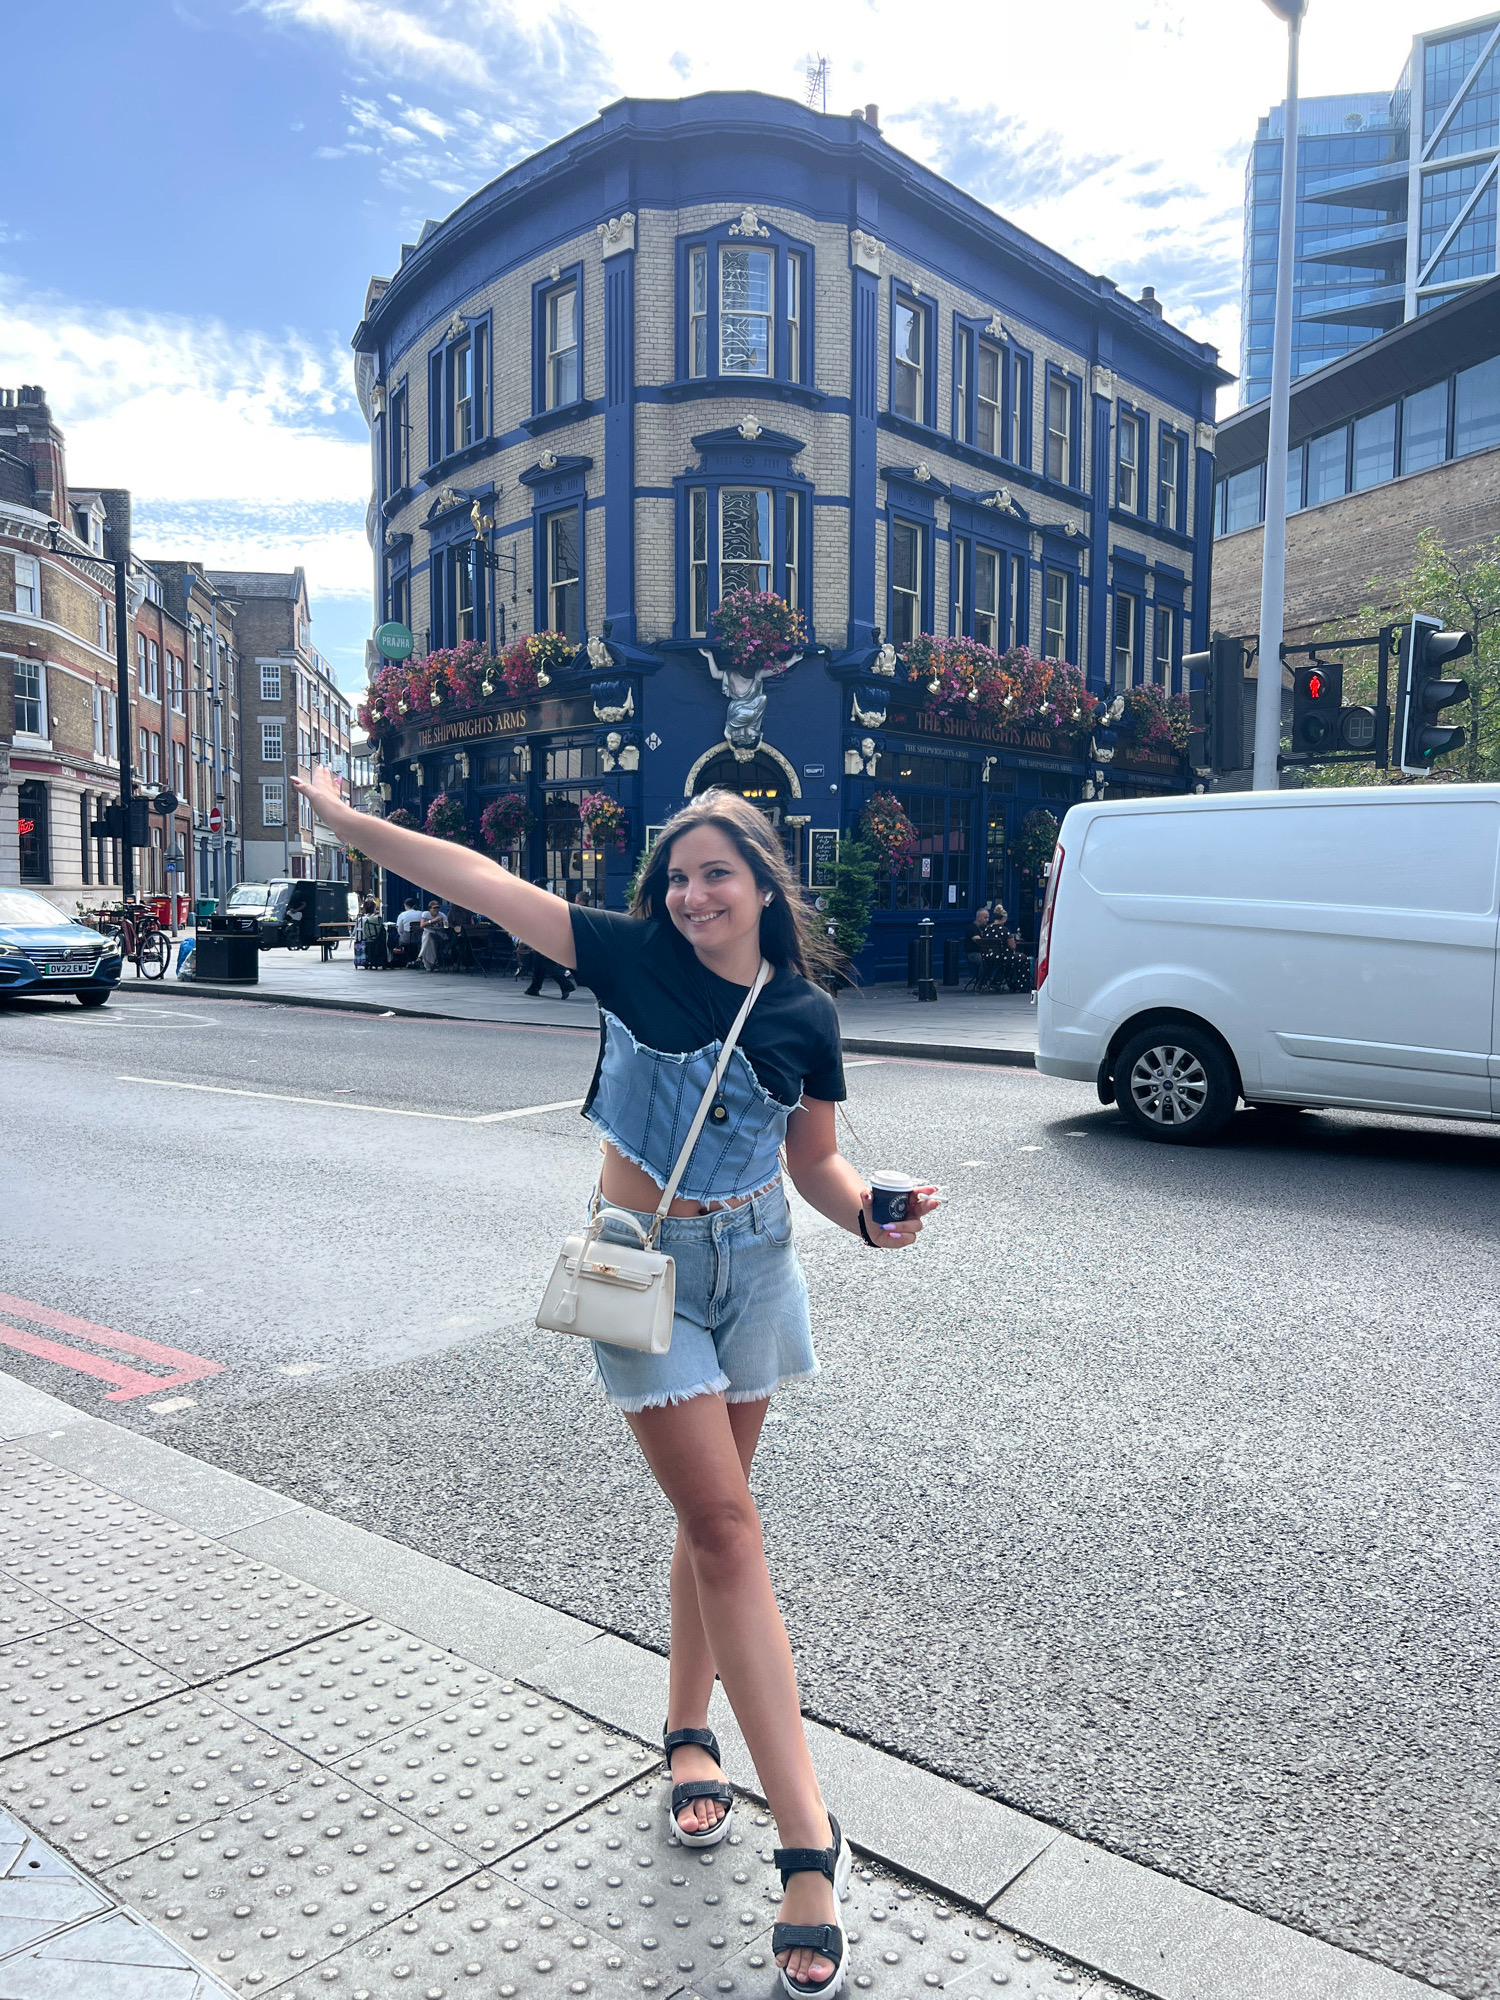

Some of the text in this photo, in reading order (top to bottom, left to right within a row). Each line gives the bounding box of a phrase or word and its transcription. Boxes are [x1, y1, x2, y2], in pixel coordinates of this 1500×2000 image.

[382, 636, 410, 649] PRAVHA
[417, 728, 432, 747] THE
[433, 715, 493, 744] SHIPWRIGHTS
[495, 709, 527, 731] ARMS
[916, 712, 941, 732] THE
[943, 717, 1021, 746] SHIPWRIGHTS
[1023, 730, 1051, 749] ARMS
[904, 743, 969, 759] THE SHIPWRIGHTS ARMS
[51, 965, 72, 973] OV22
